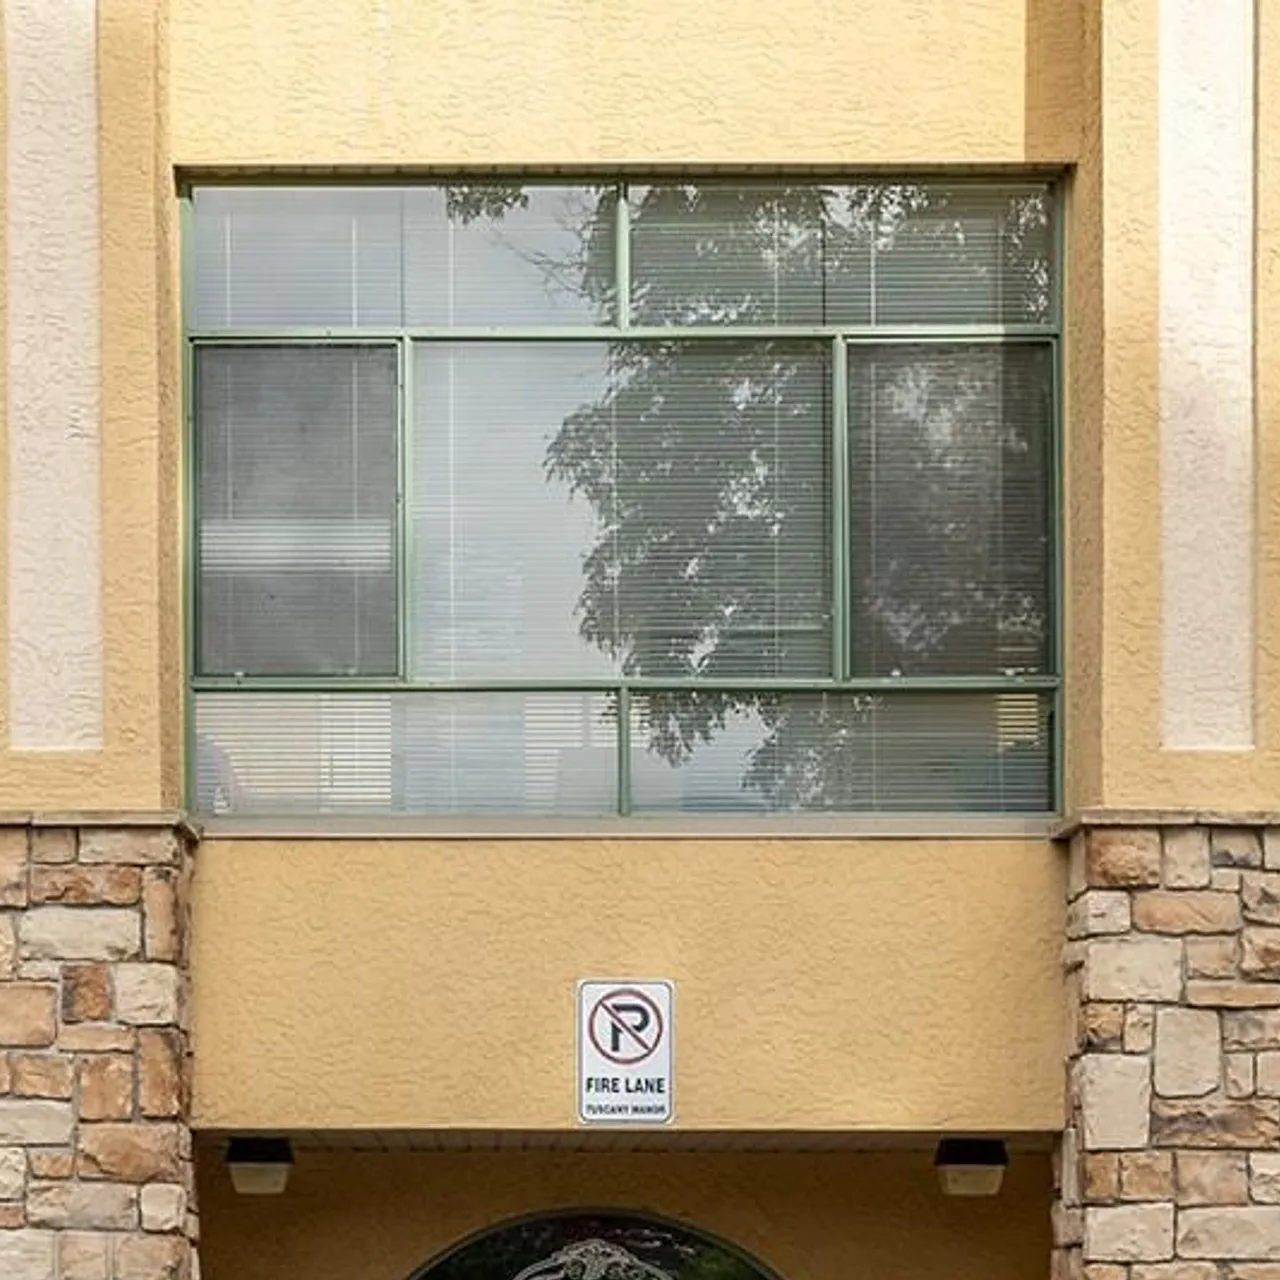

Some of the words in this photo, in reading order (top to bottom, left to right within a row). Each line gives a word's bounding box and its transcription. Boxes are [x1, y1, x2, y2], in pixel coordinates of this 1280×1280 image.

[586, 1077, 620, 1094] FIRE
[625, 1077, 666, 1094] LANE
[586, 1103, 629, 1115] TUSCANY
